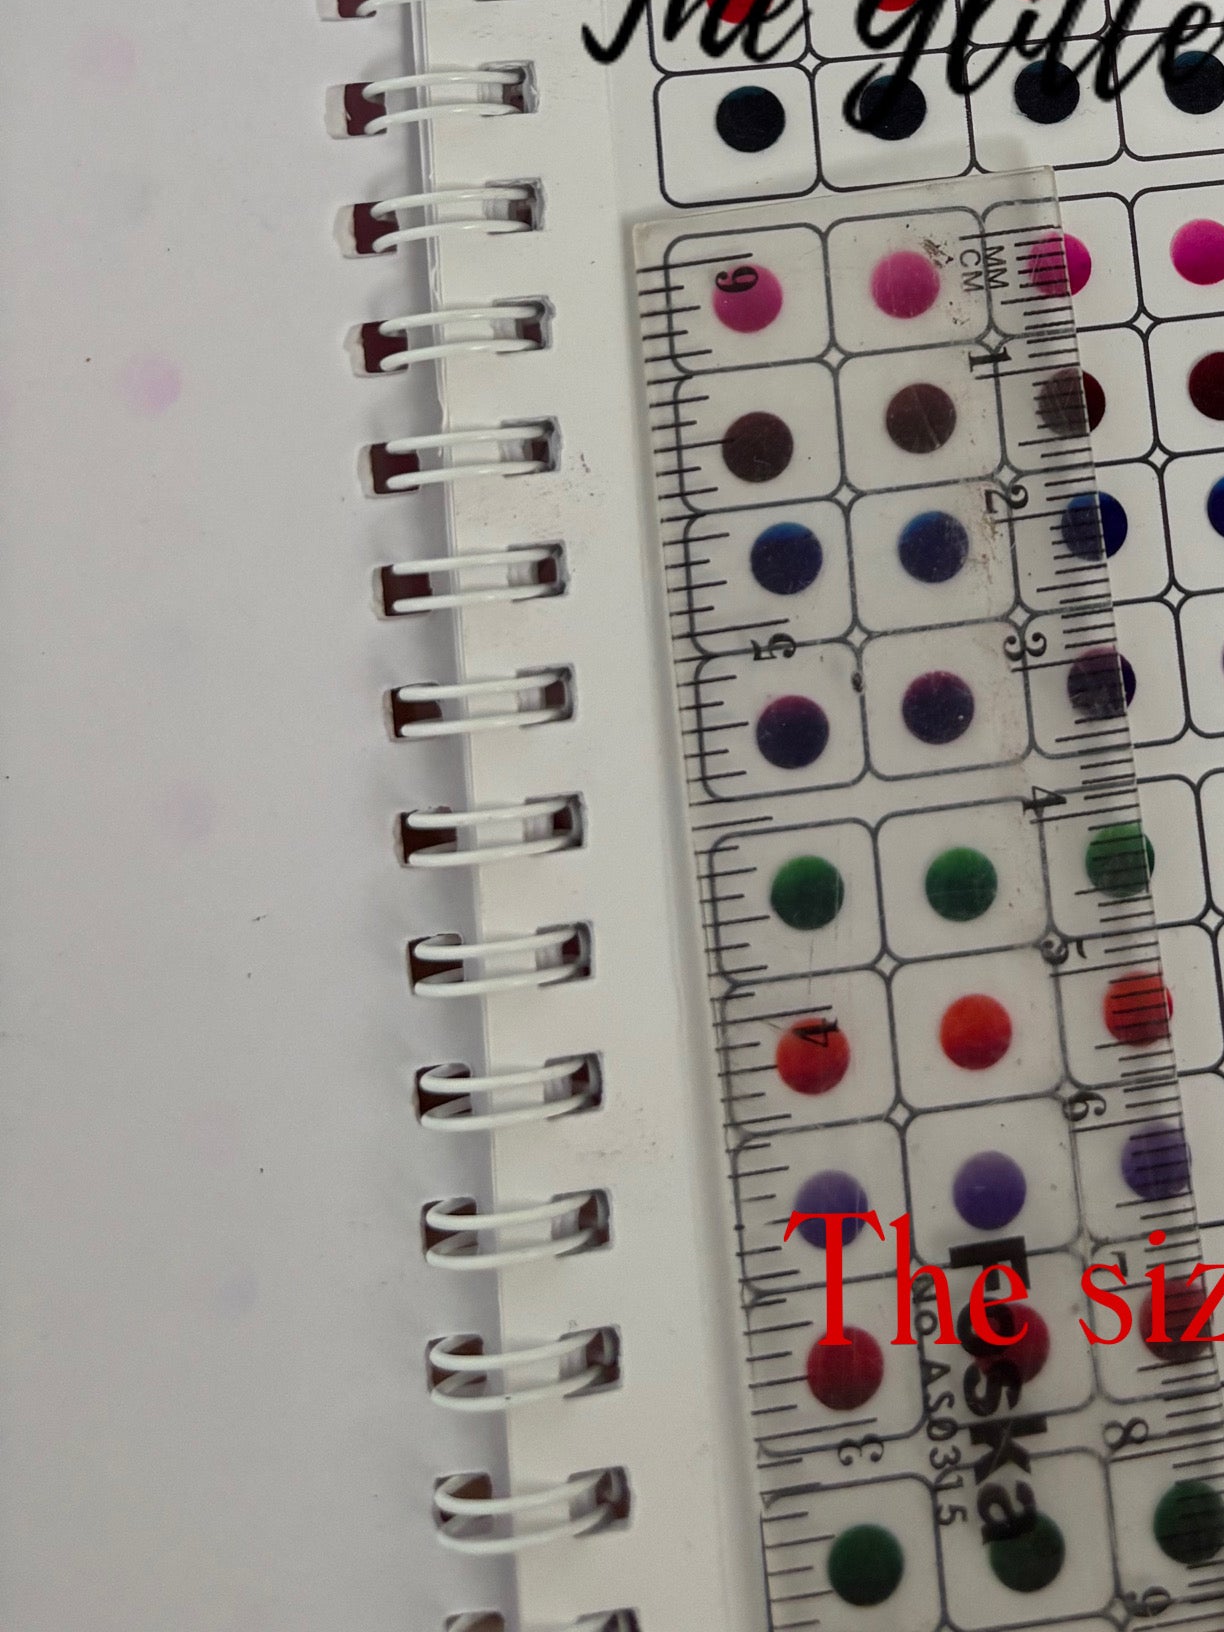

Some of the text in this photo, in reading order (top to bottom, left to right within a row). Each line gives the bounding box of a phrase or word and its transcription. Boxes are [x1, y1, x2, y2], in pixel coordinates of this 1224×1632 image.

[958, 248, 985, 293] CM
[985, 245, 1010, 291] MM
[967, 348, 1012, 373] 1
[983, 485, 1030, 515] 2
[750, 632, 797, 661] 5
[1002, 631, 1048, 661] 3
[1022, 785, 1068, 818] 4
[793, 1016, 840, 1048] 4
[1062, 1092, 1107, 1122] 6
[1103, 1417, 1150, 1450] 8
[836, 1434, 885, 1466] 3
